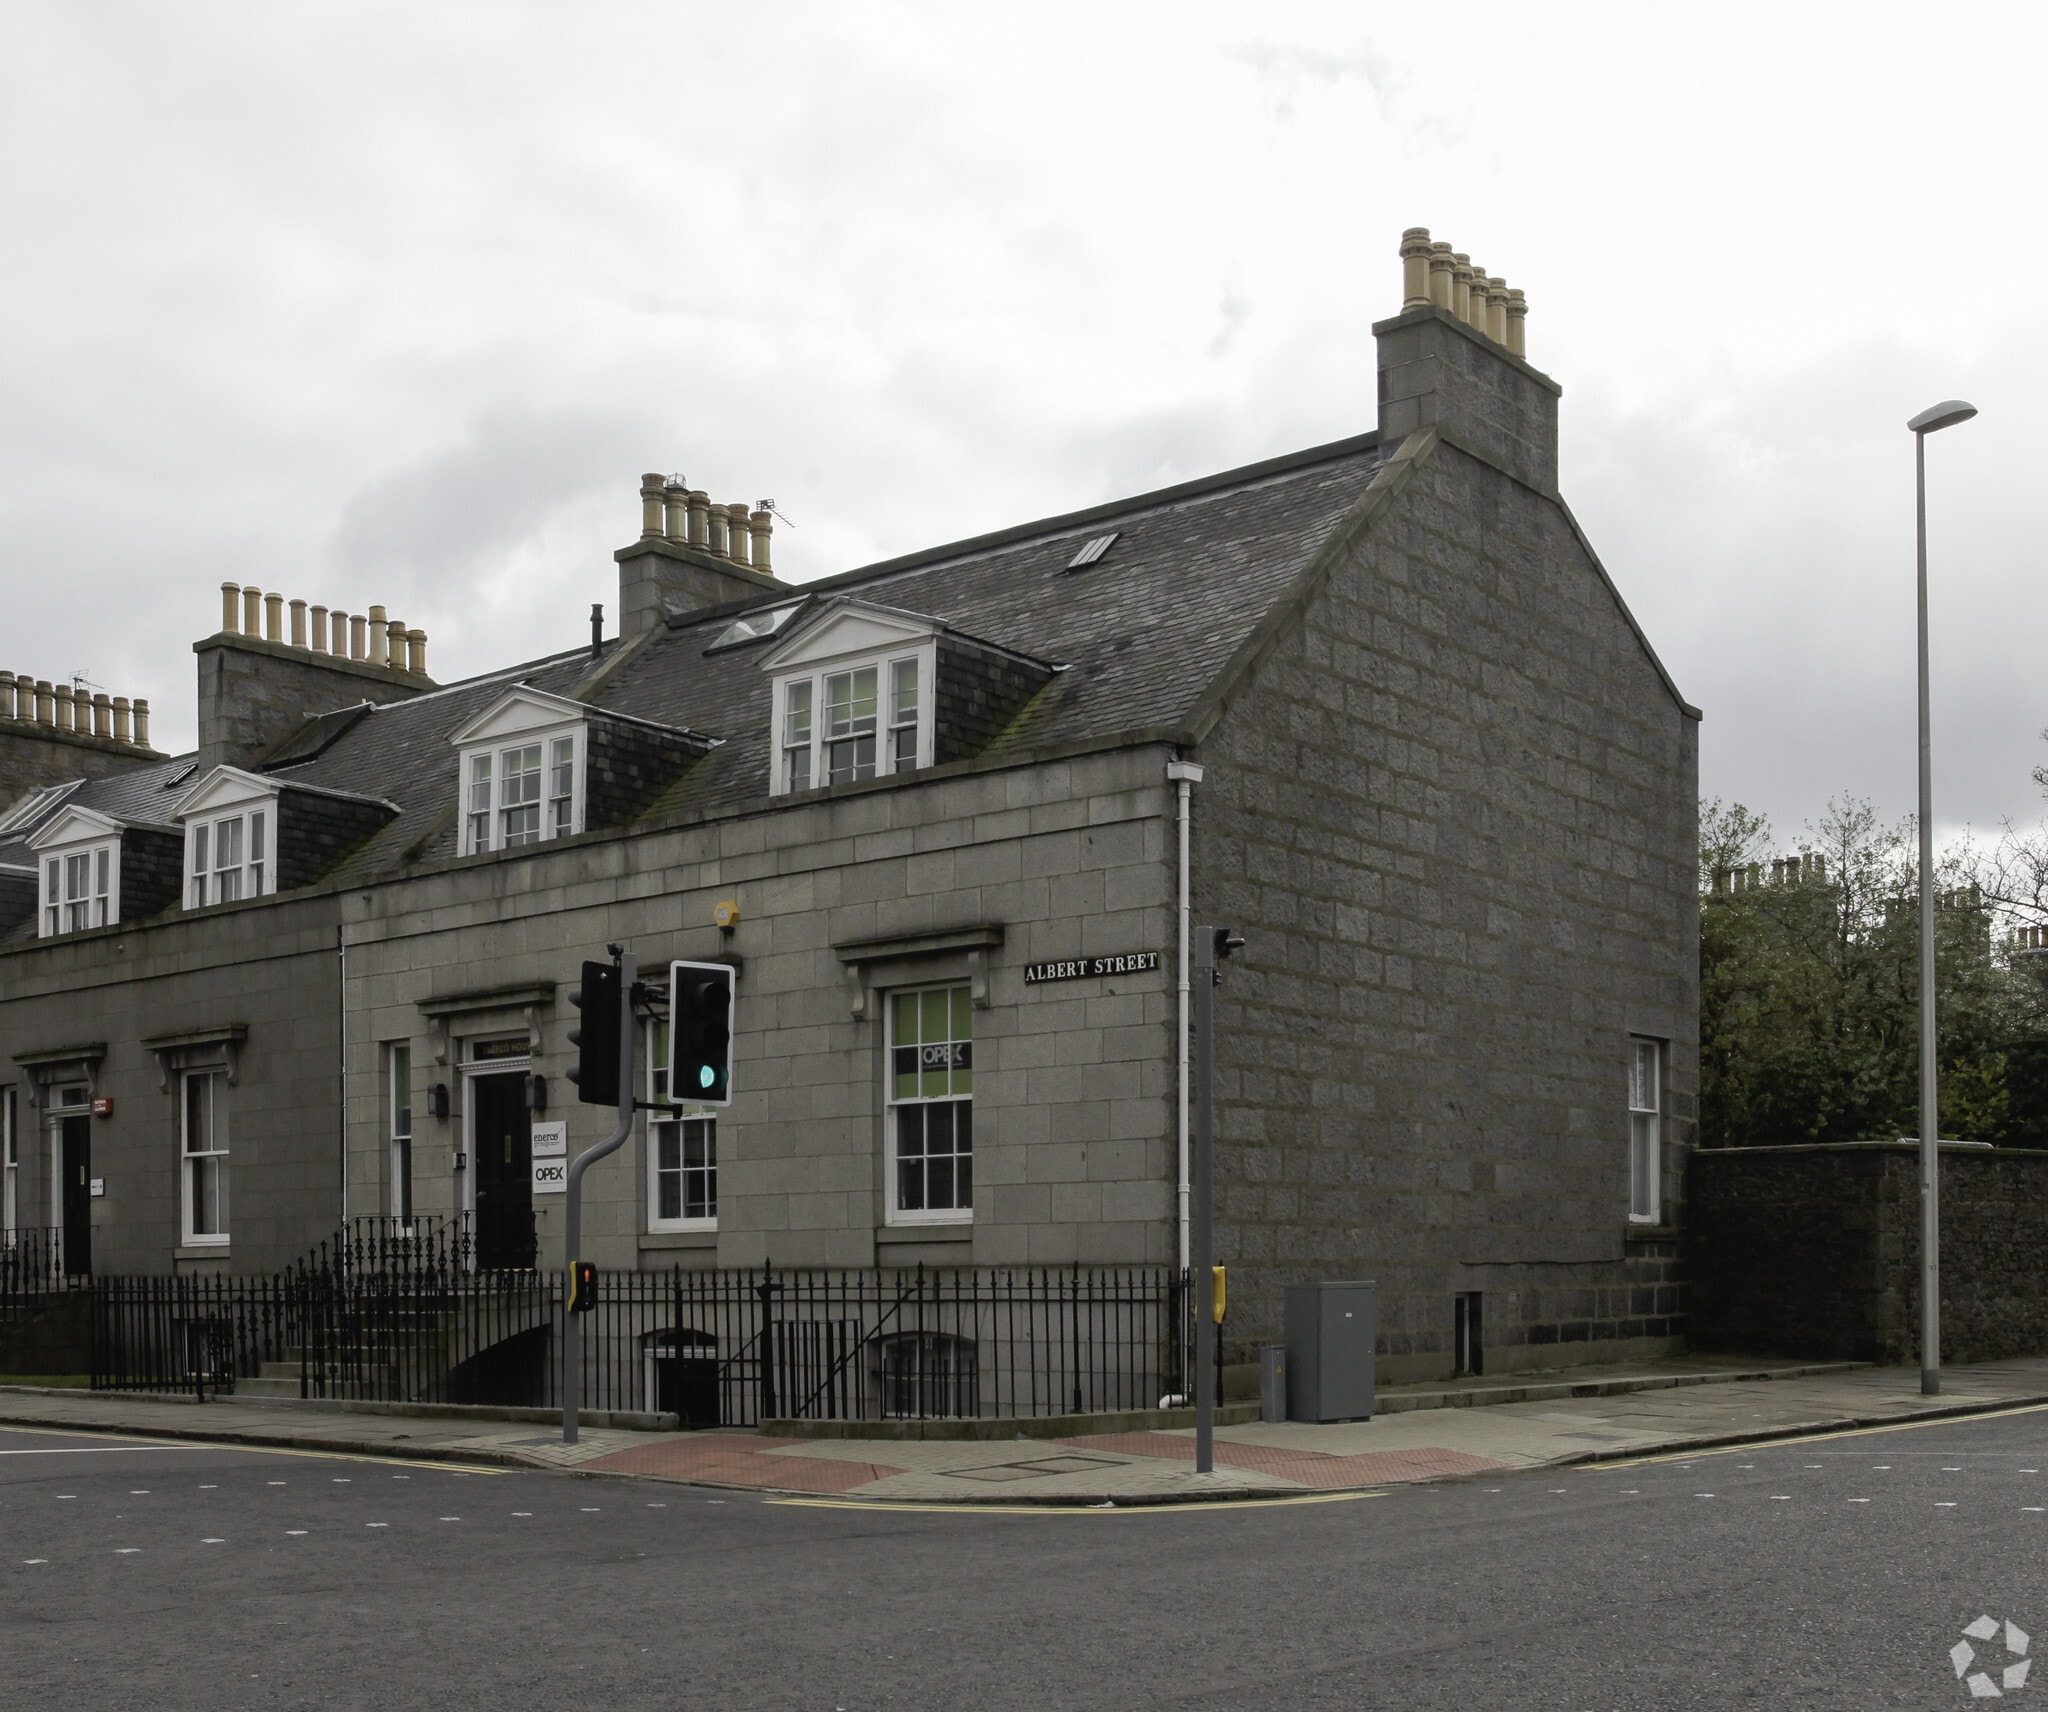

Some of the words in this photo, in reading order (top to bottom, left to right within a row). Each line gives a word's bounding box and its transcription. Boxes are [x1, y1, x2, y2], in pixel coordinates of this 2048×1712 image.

[1025, 960, 1088, 981] ALBERT
[1094, 952, 1157, 974] STREET
[923, 1044, 963, 1064] OPEX
[535, 1166, 563, 1181] OPEX
